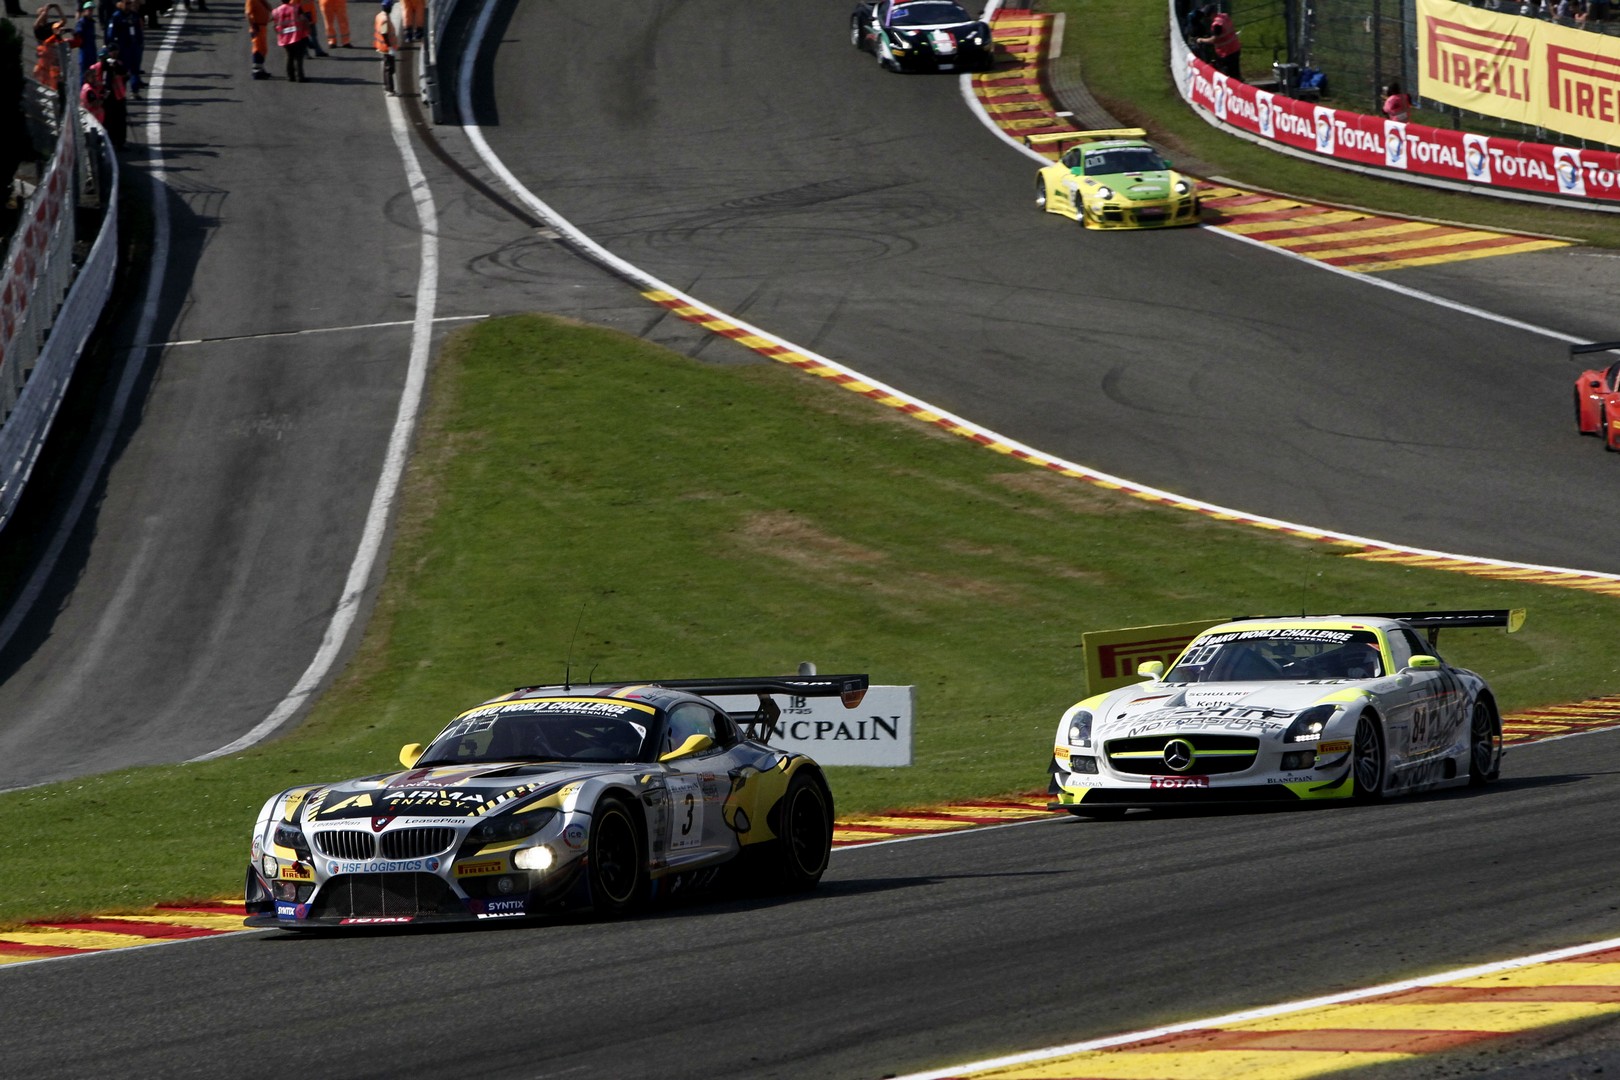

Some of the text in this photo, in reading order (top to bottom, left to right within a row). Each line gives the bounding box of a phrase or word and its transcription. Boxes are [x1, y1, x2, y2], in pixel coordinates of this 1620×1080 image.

[1427, 15, 1530, 102] PIRELLI
[1547, 43, 1620, 124] PIRE
[1226, 87, 1259, 122] TOTAL
[1273, 104, 1316, 139] TOTAL
[1334, 120, 1384, 154] TOTAL
[1406, 134, 1464, 169] TOTAL
[1489, 148, 1555, 181] TOTAL
[1583, 161, 1620, 188] TO
[1205, 632, 1240, 646] BAKU
[1237, 629, 1281, 640] WORLD
[1280, 629, 1353, 642] CHALLENGE
[500, 702, 549, 714] WORLD
[548, 702, 632, 715] CHALLENGE
[1412, 706, 1426, 743] 84
[1320, 742, 1352, 753] PIRELLI
[1152, 777, 1208, 788] TOTAL
[1267, 775, 1313, 784] BLANCPAIN
[390, 799, 465, 808] ENERGY
[682, 793, 695, 836] 3
[312, 820, 361, 828] LeasePlan
[341, 860, 421, 873] HSF LOGISTICS
[457, 861, 501, 875] PIRELLI
[277, 906, 296, 916] SYNTIX
[488, 900, 524, 911] SYNTIX
